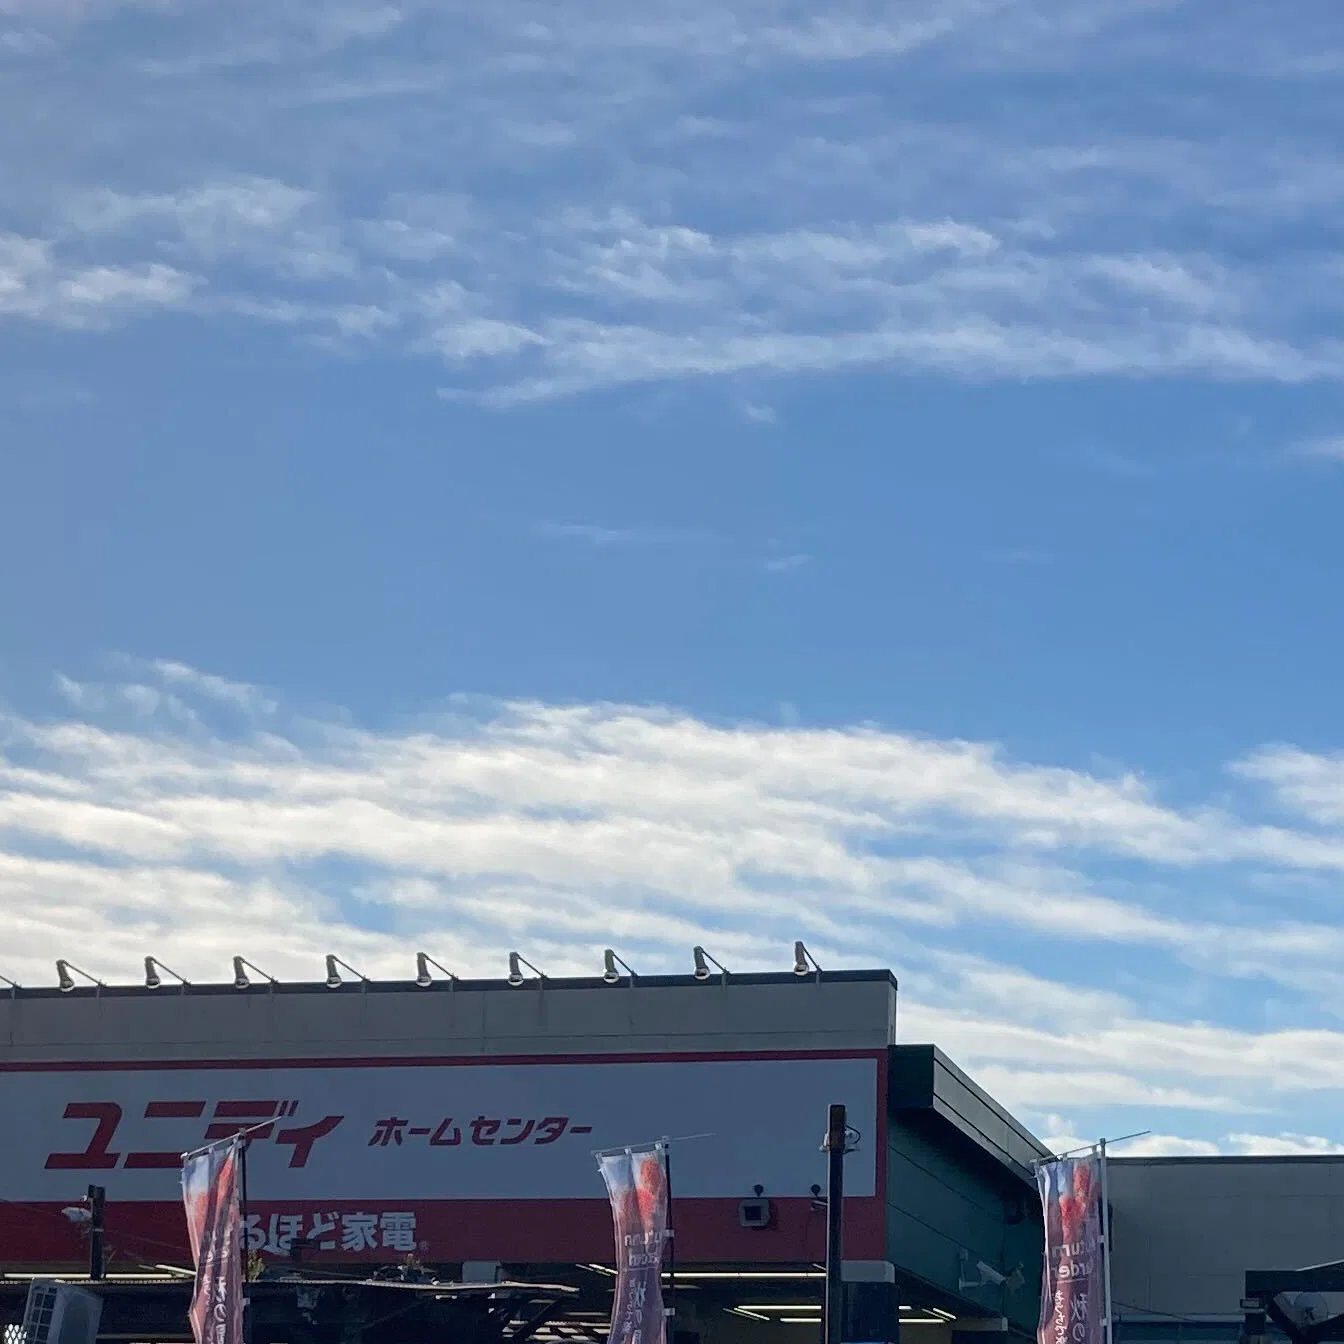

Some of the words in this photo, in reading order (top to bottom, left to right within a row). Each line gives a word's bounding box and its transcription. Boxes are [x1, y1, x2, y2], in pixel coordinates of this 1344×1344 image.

[43, 1100, 345, 1170] ユニディ
[367, 1115, 593, 1147] ホームセンター
[236, 1210, 418, 1256] るほど家電
